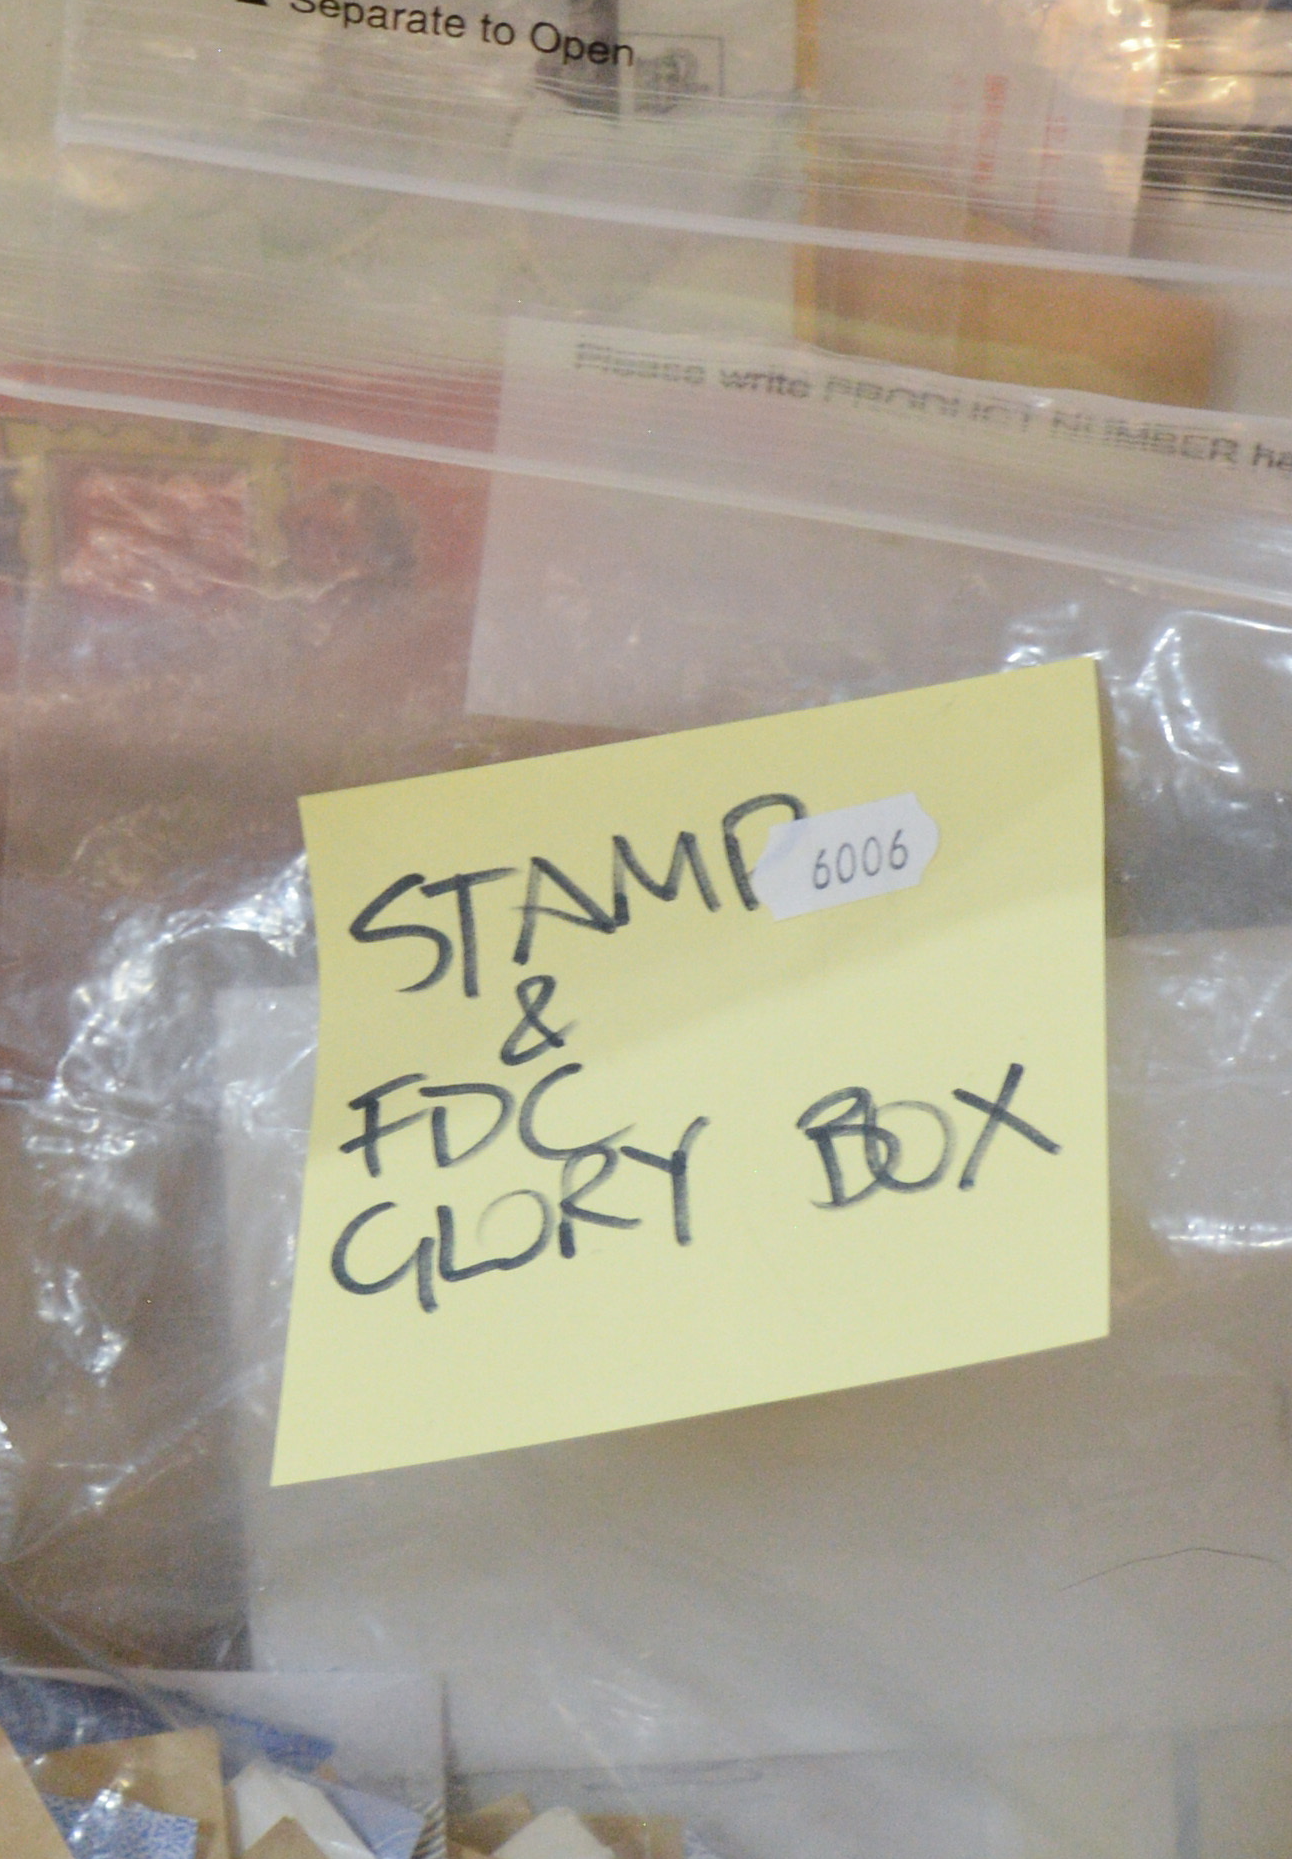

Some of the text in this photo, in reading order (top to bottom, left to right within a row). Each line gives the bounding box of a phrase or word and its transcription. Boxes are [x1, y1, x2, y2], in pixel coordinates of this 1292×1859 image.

[481, 11, 517, 47] to
[528, 21, 635, 70] Open
[719, 367, 810, 399] write
[812, 828, 909, 890] 6006
[499, 972, 575, 1066] &
[339, 1062, 636, 1177] FDC
[329, 1062, 1062, 1312] GLORY BOX
